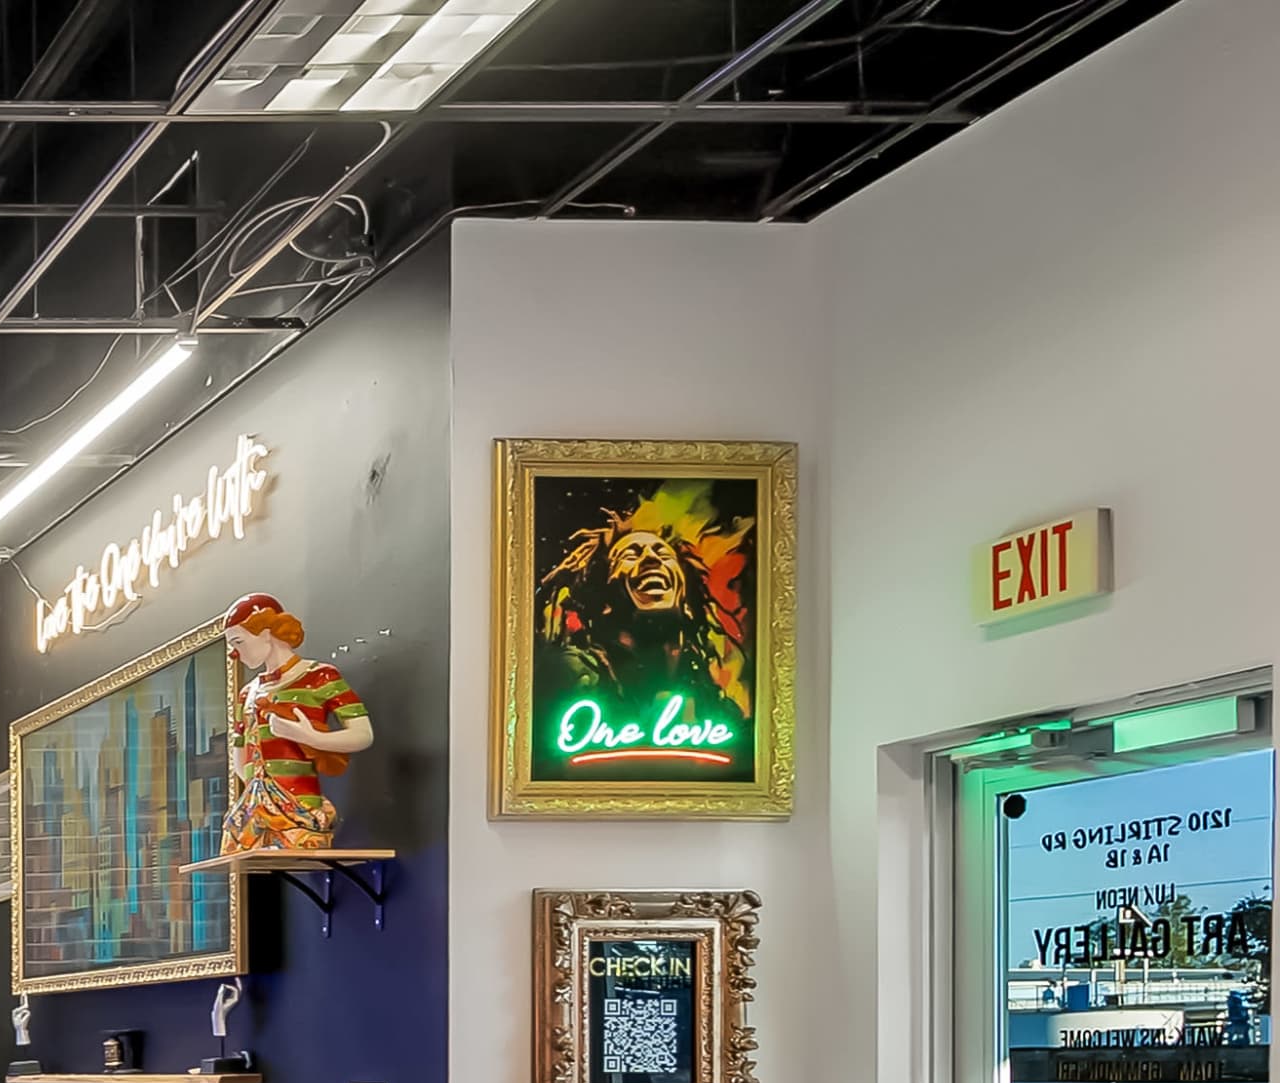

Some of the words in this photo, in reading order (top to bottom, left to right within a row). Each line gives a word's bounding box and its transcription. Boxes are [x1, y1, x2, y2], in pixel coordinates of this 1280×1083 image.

[992, 520, 1073, 611] EXIT
[557, 698, 646, 753] One
[652, 694, 734, 746] love
[589, 957, 665, 978] CHECK
[669, 957, 692, 976] IN
